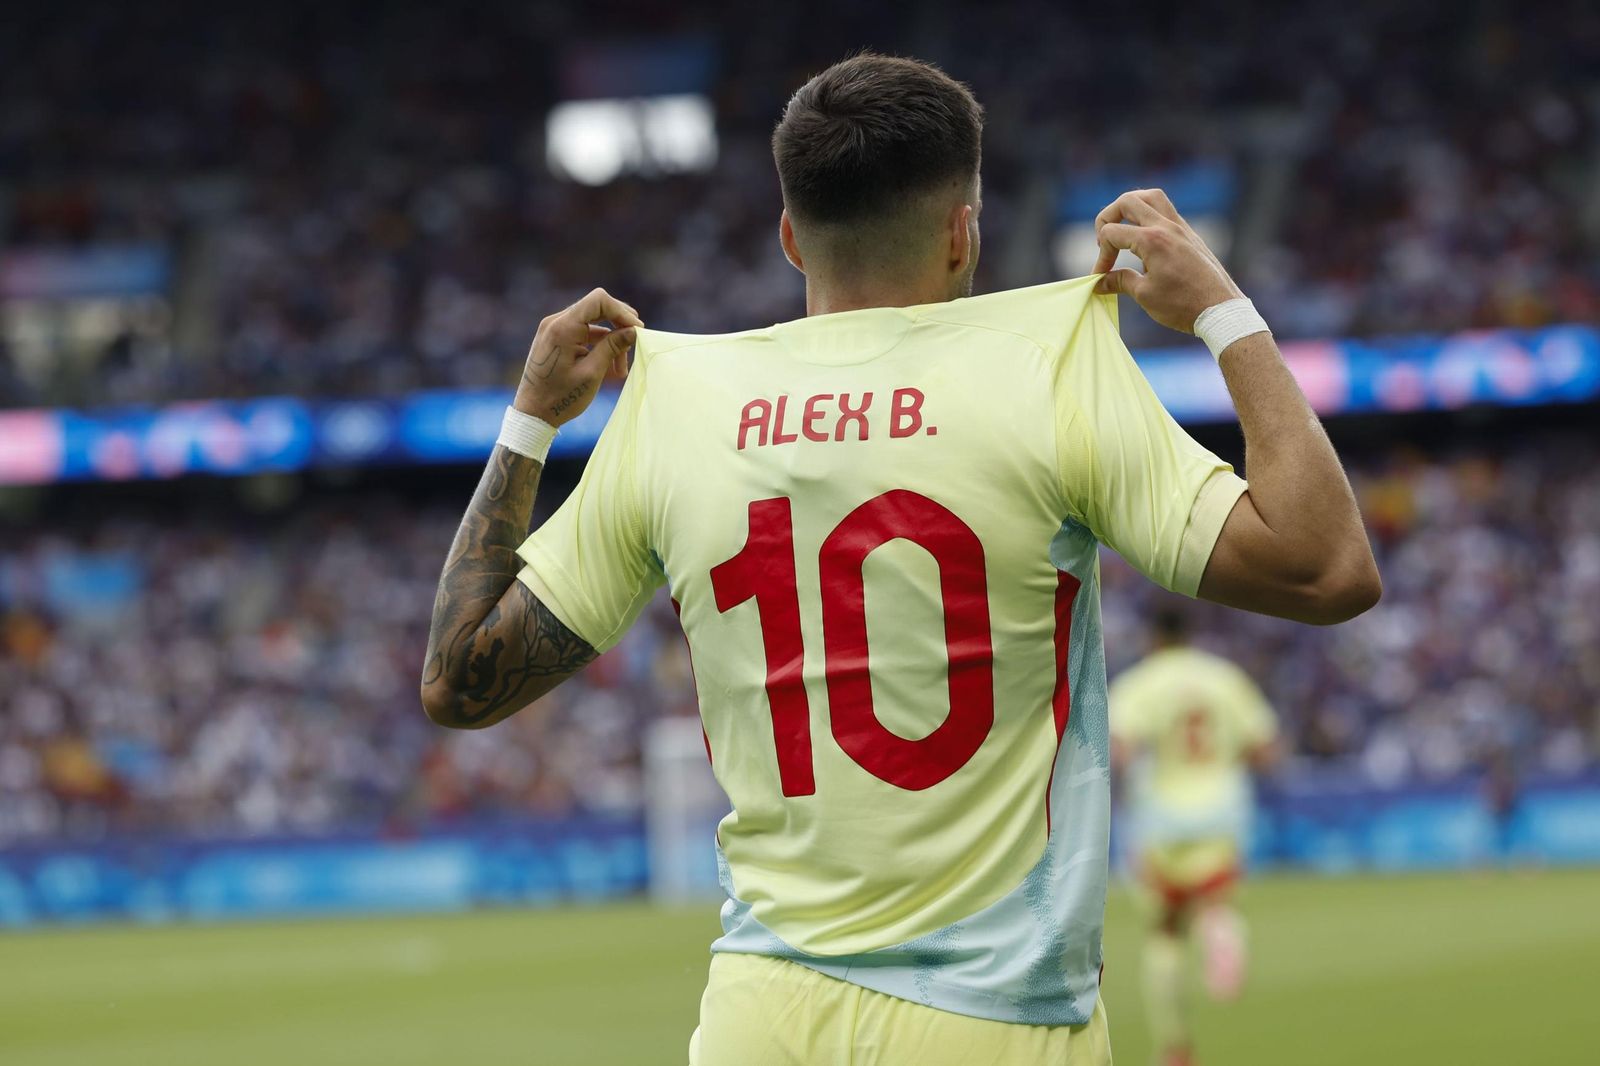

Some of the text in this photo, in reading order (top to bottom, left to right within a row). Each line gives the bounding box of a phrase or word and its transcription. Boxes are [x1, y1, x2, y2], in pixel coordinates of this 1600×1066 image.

[738, 387, 937, 449] ALEX B.
[711, 489, 993, 797] 10
